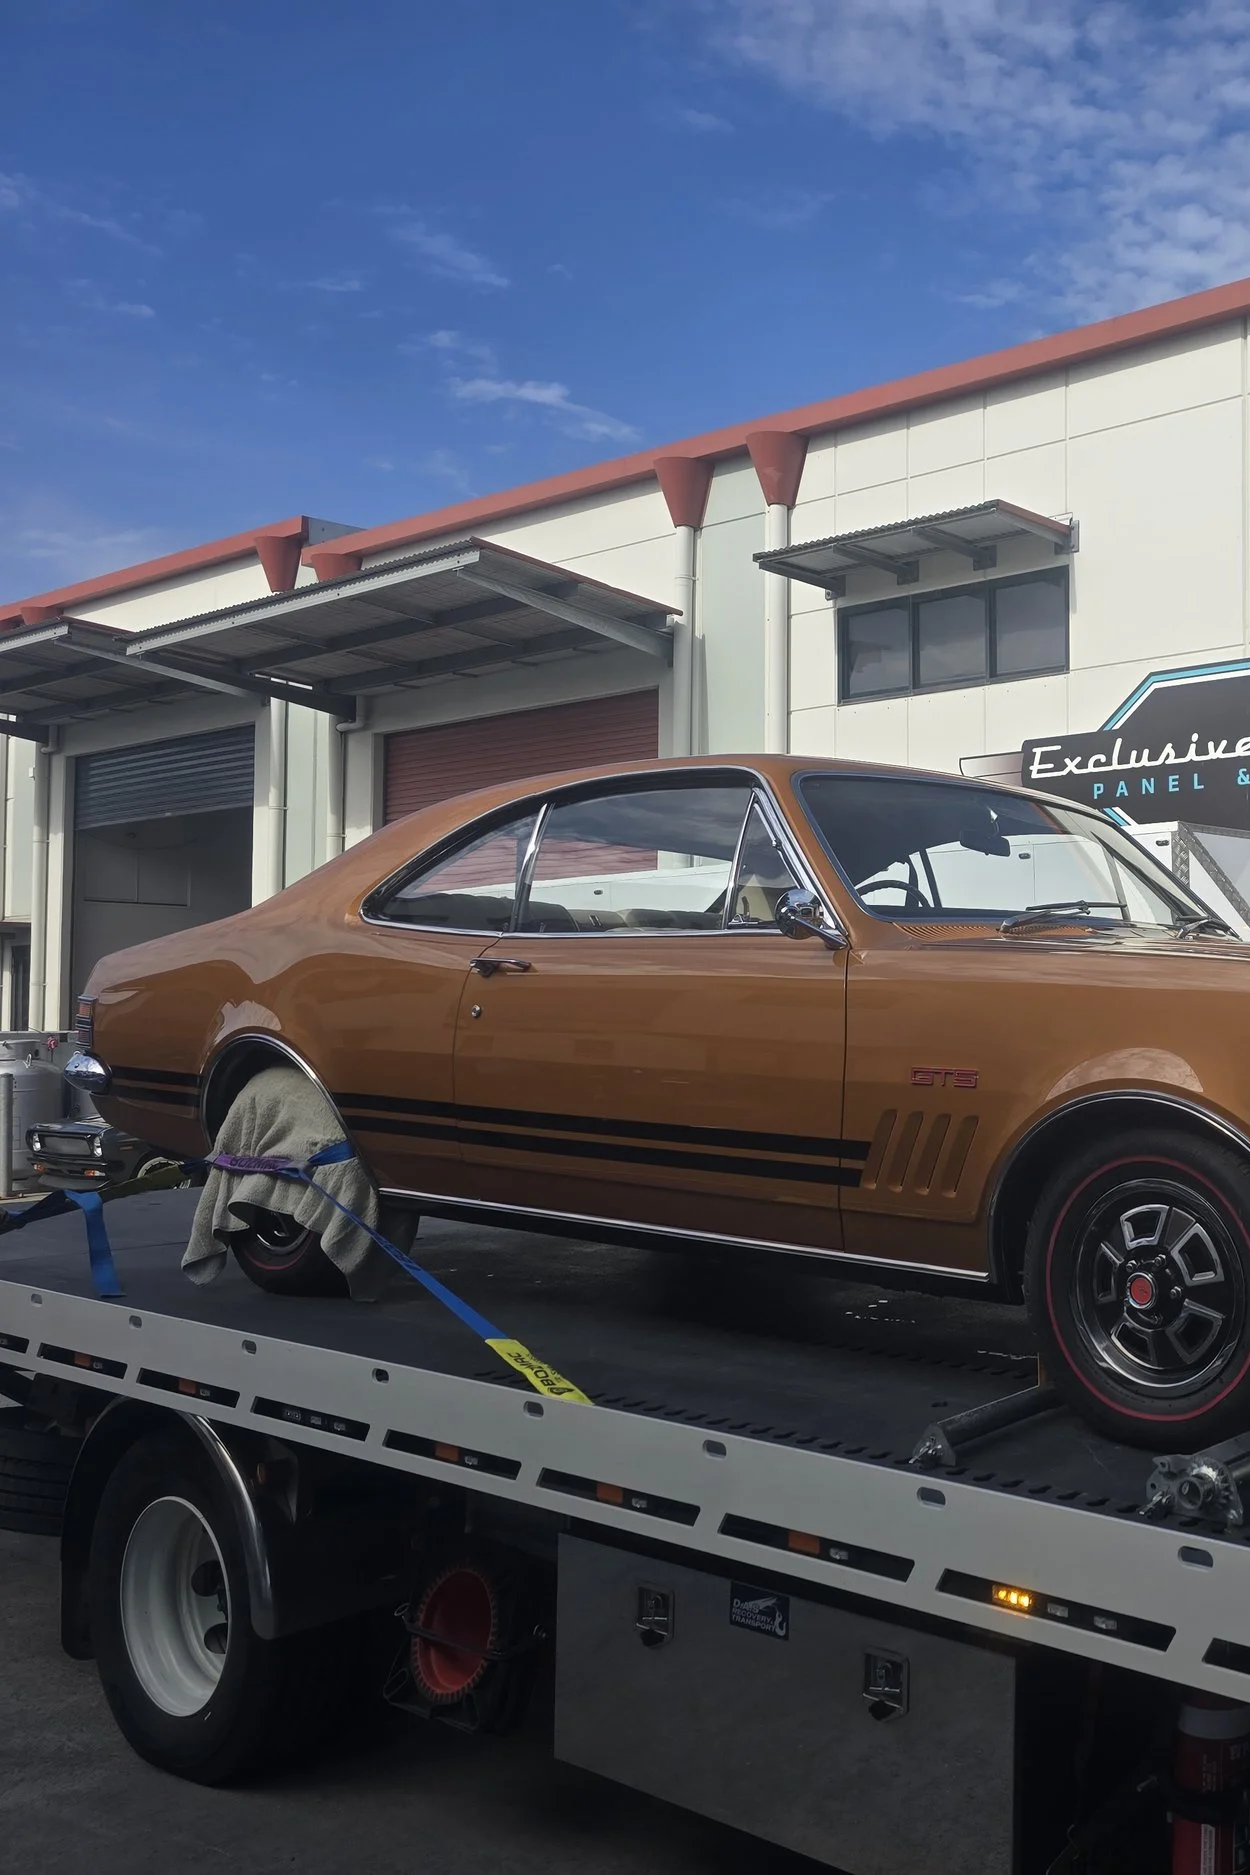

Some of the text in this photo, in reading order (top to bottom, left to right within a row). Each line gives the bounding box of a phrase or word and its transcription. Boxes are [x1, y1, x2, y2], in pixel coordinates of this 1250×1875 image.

[1093, 773, 1205, 799] PANEL
[909, 1066, 979, 1088] GTS
[732, 1614, 777, 1633] TRANSPORT
